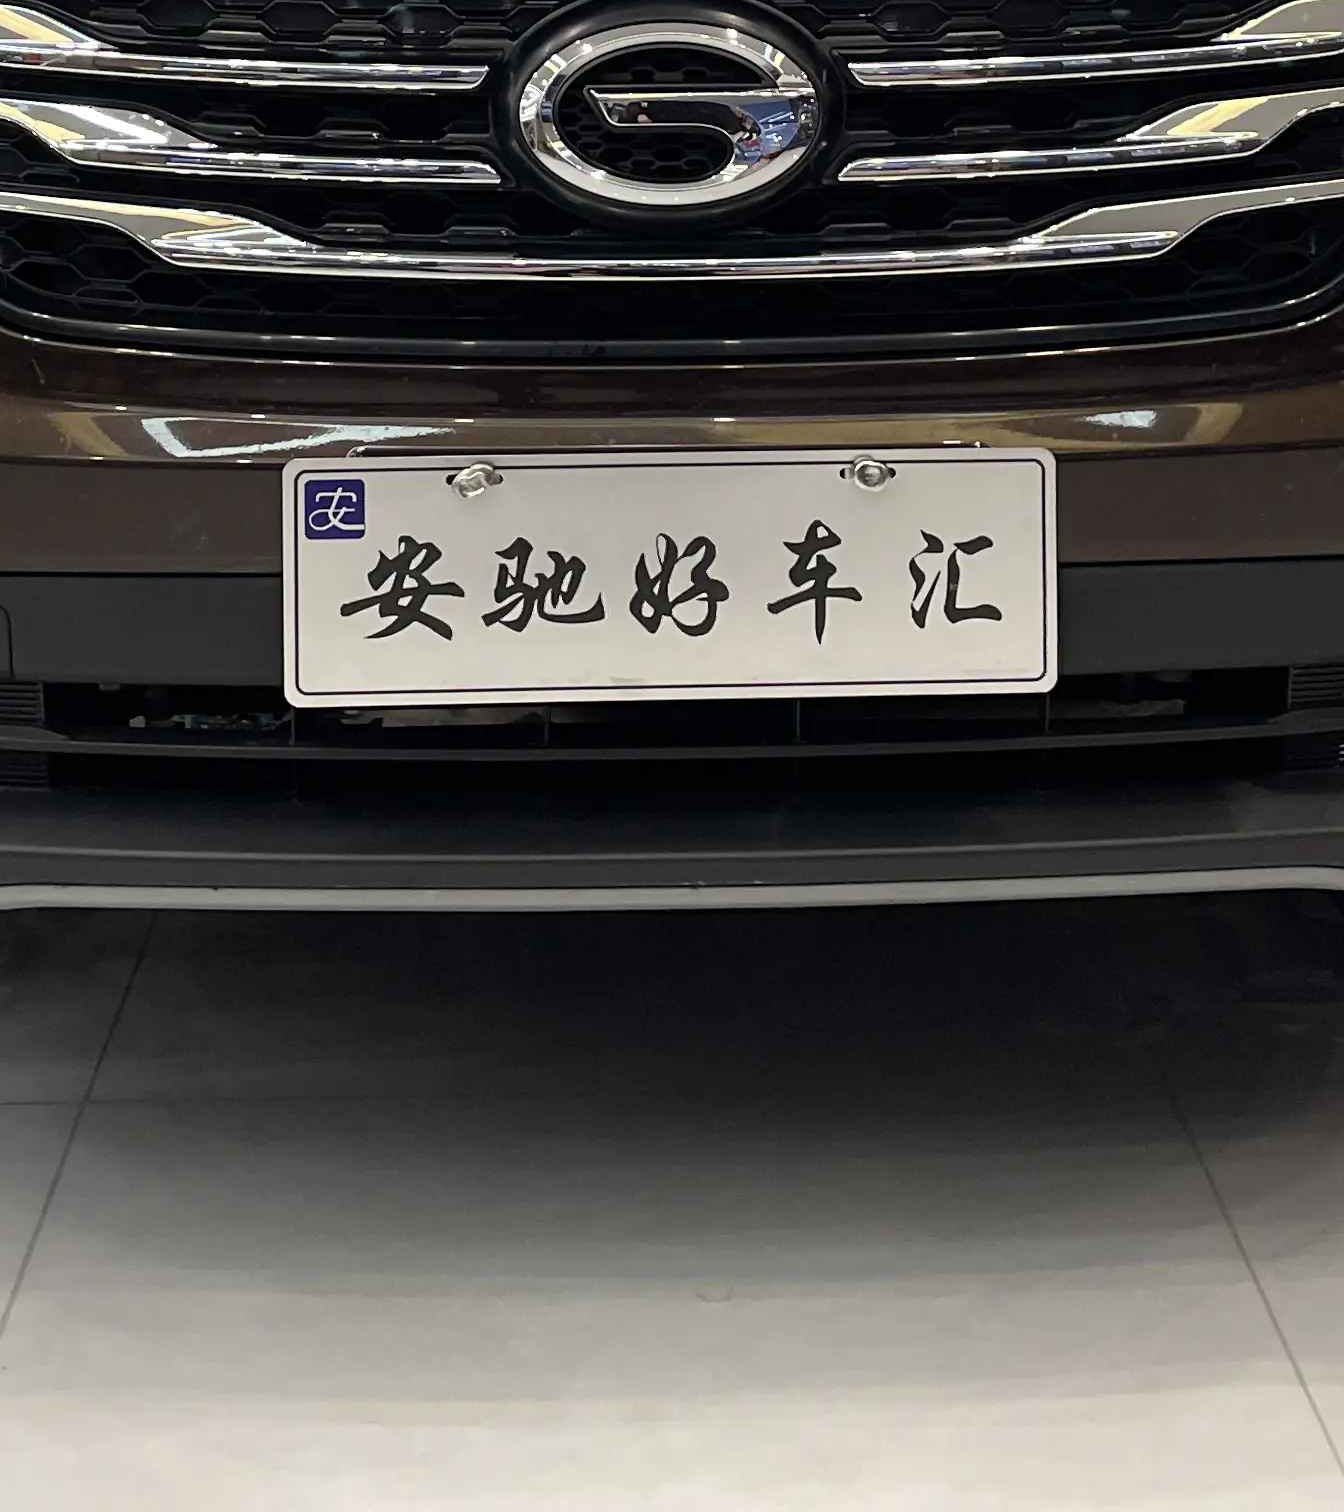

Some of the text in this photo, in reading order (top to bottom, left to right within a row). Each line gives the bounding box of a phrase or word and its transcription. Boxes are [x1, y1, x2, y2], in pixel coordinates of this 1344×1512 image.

[340, 519, 1003, 645] 安驰好车汇
